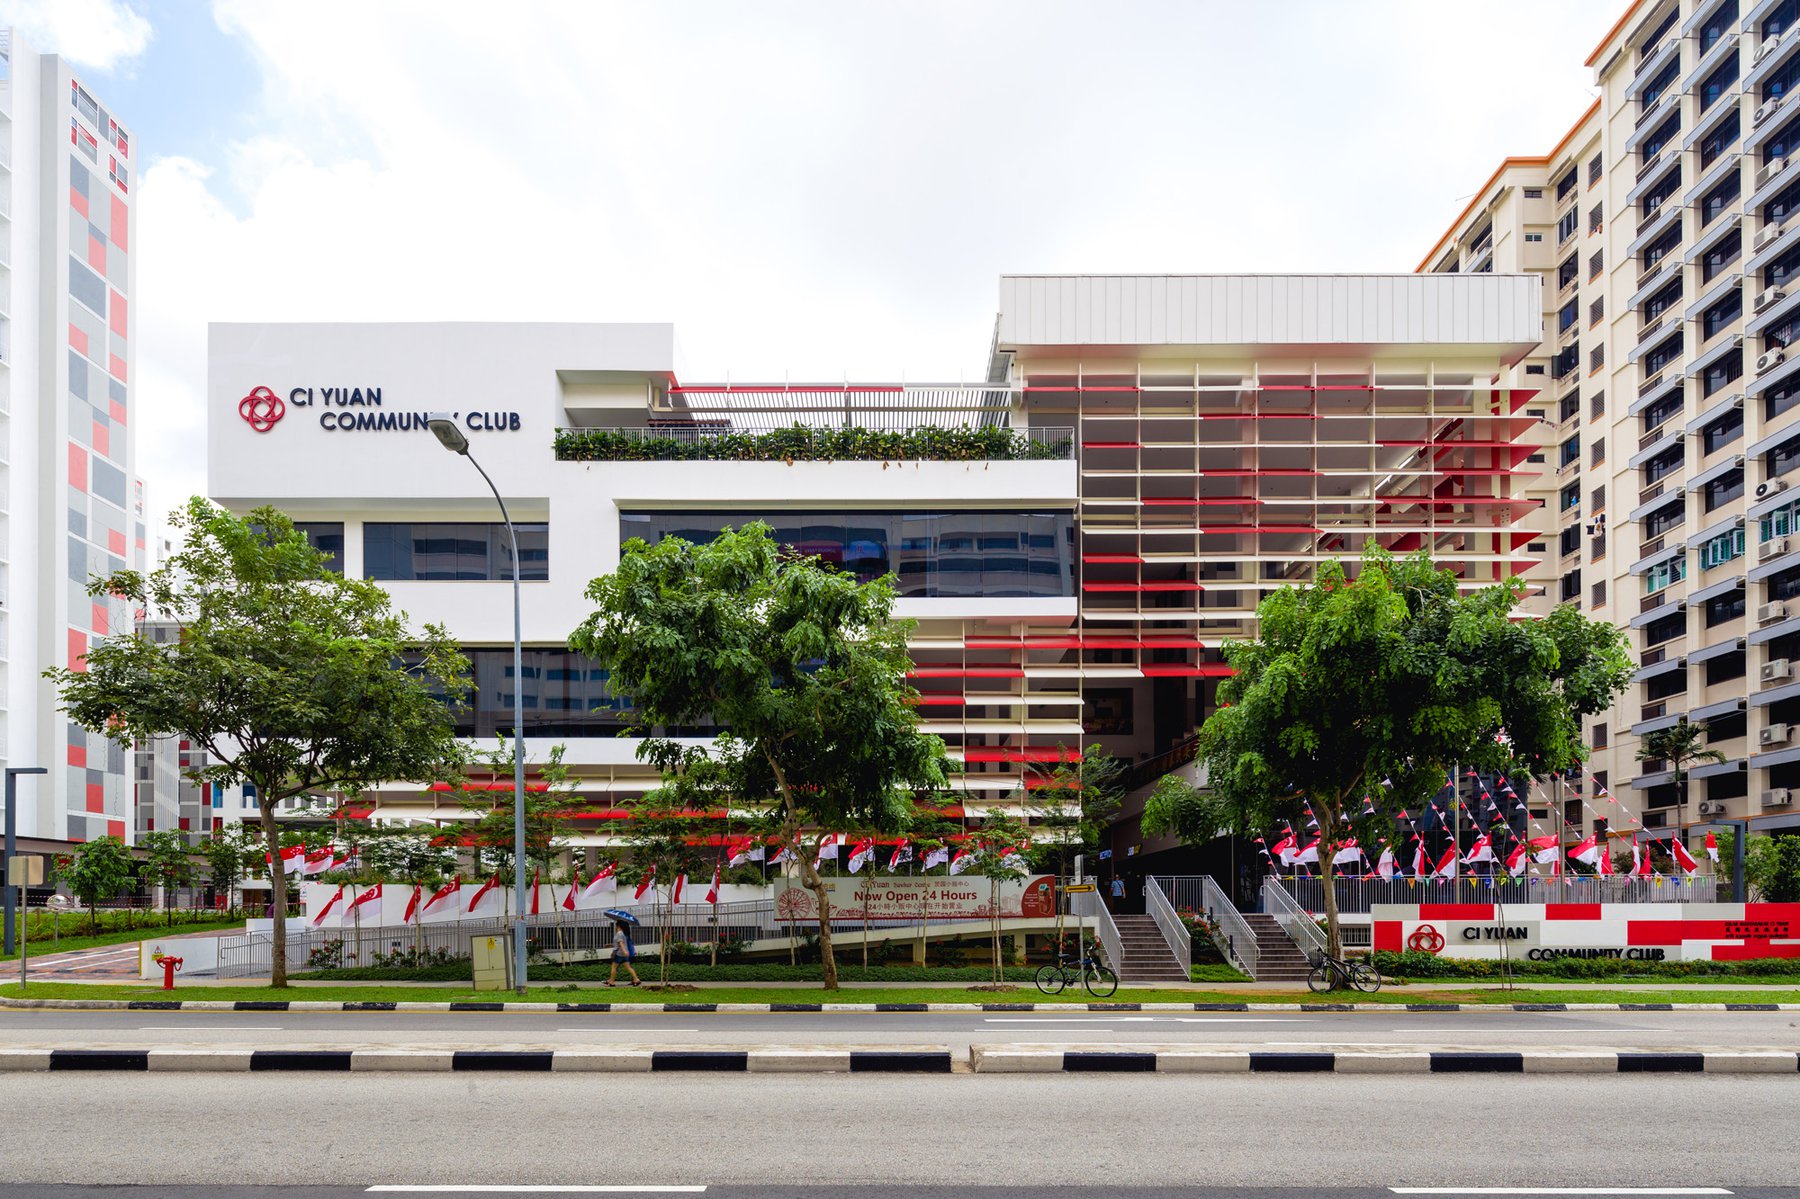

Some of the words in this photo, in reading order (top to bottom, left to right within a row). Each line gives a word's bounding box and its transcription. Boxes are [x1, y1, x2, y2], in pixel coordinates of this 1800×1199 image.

[289, 387, 313, 406] CI
[320, 387, 382, 406] YUAN
[320, 412, 459, 431] COMMUN
[466, 412, 521, 431] CLUB
[854, 891, 882, 901] Now
[886, 891, 918, 903] Open
[941, 890, 977, 900] Hours
[1463, 926, 1480, 940] CI
[1484, 926, 1528, 940] YUAN
[1626, 948, 1666, 961] CLUB
